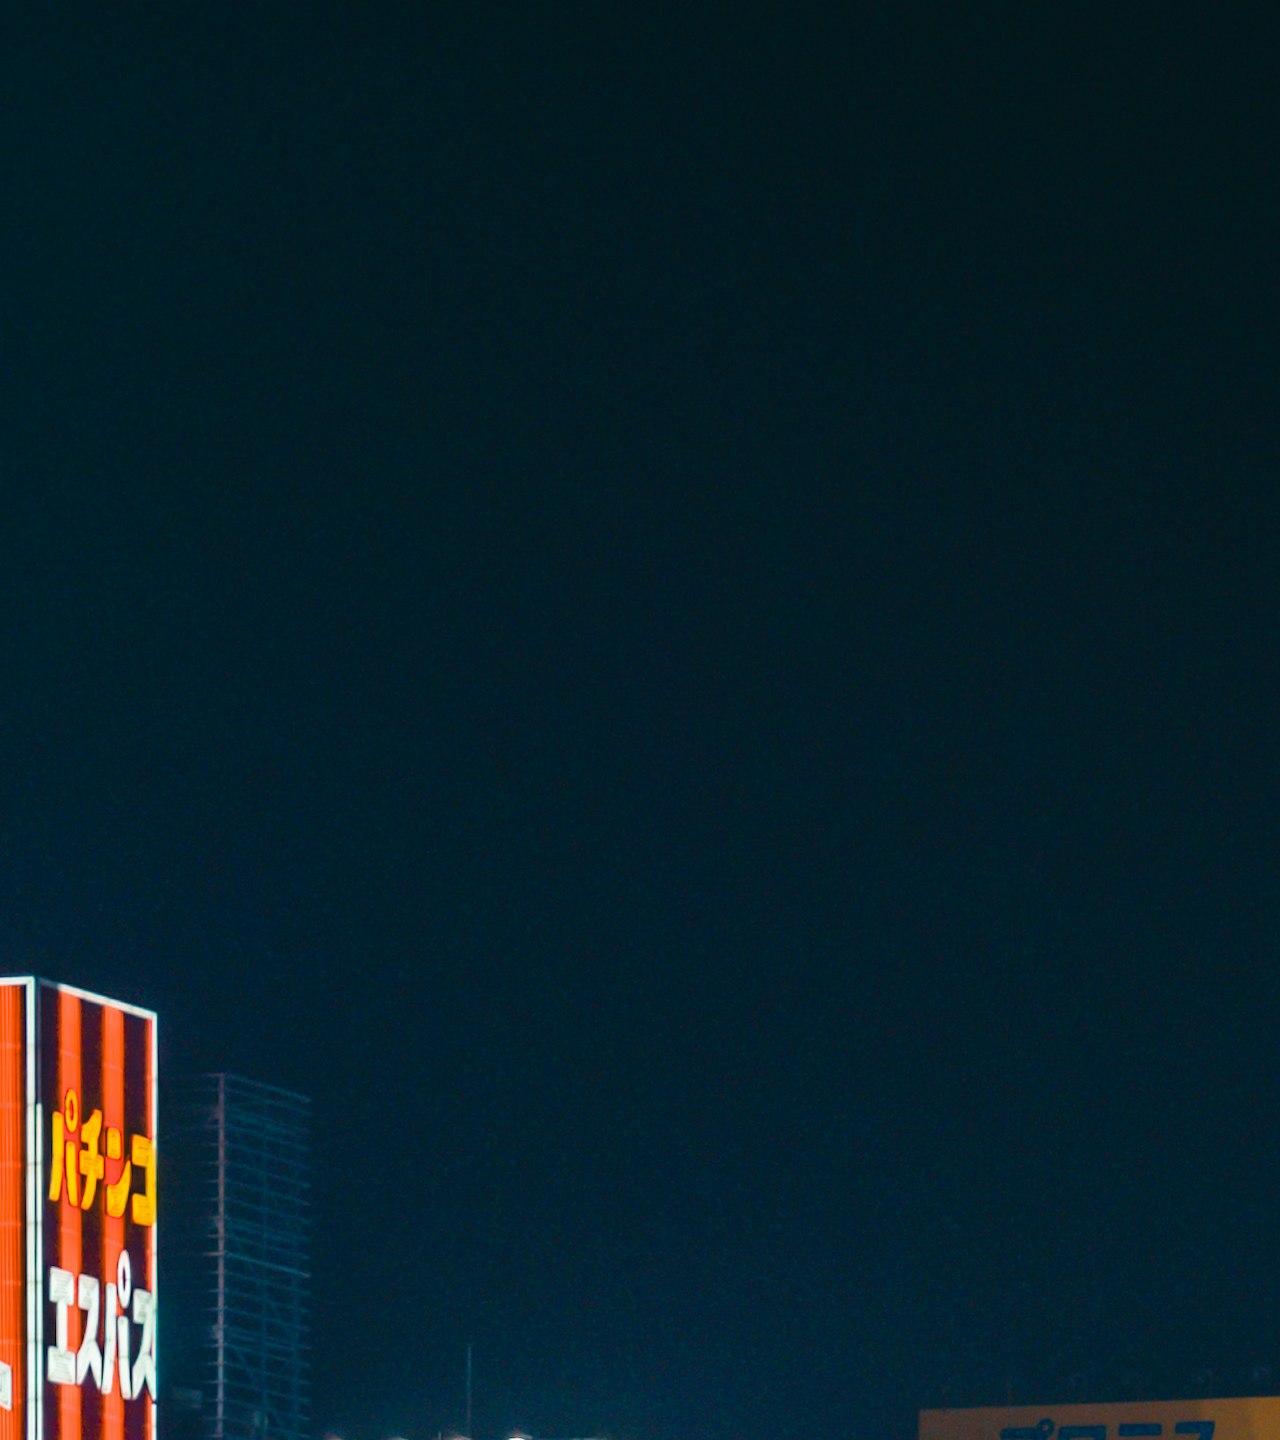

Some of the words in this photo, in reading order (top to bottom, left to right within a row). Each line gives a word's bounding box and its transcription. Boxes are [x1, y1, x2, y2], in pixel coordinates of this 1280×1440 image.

[49, 1089, 154, 1227] パチンコ
[47, 1250, 156, 1400] エスパス
